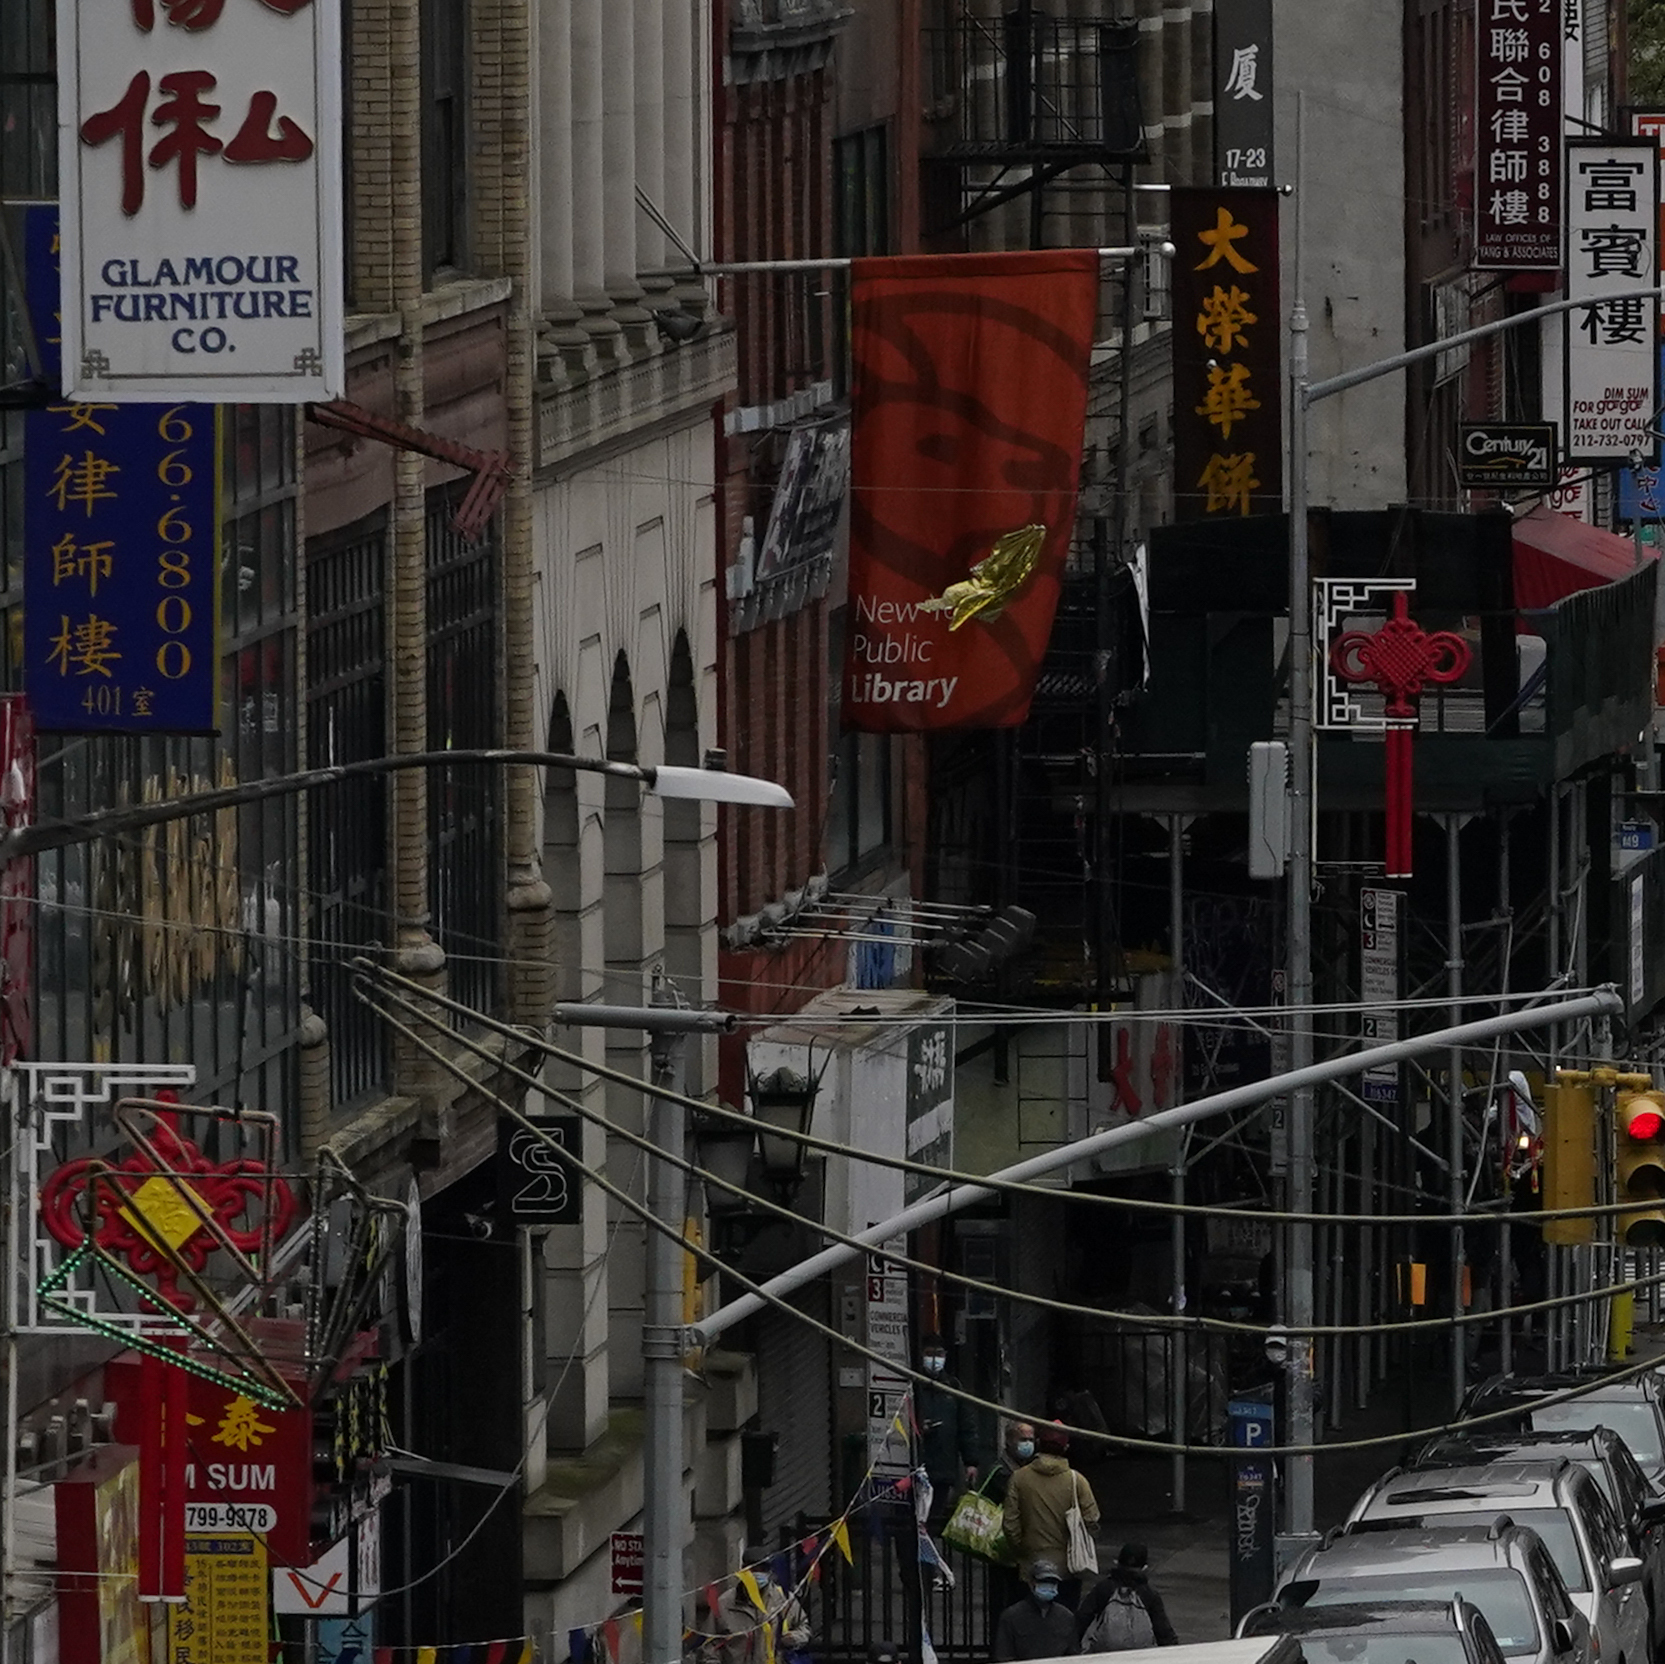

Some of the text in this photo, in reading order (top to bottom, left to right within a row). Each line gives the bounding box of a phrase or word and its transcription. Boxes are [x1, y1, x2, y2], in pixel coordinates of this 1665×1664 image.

[80, 0, 313, 216] 俬
[1226, 148, 1266, 169] 17-23
[1485, 233, 1502, 244] LAW
[1579, 159, 1648, 345] 富賓樓
[102, 256, 299, 287] GLAMOUR
[91, 290, 312, 322] FURNITURE
[172, 327, 235, 354] CO.
[1604, 387, 1648, 400] DIM SUM
[1574, 401, 1594, 414] FOR
[1574, 417, 1647, 430] TAKE OUT CALL
[1466, 431, 1547, 471] Century 21
[1573, 434, 1650, 447] 212-732-0797
[855, 594, 919, 624] New
[853, 633, 933, 664] Public
[852, 672, 958, 709] Library
[1365, 1018, 1376, 1038] 2
[872, 1278, 883, 1301] 3
[873, 1394, 885, 1418] 2
[1246, 1422, 1262, 1447] P
[207, 1464, 276, 1490] SUM
